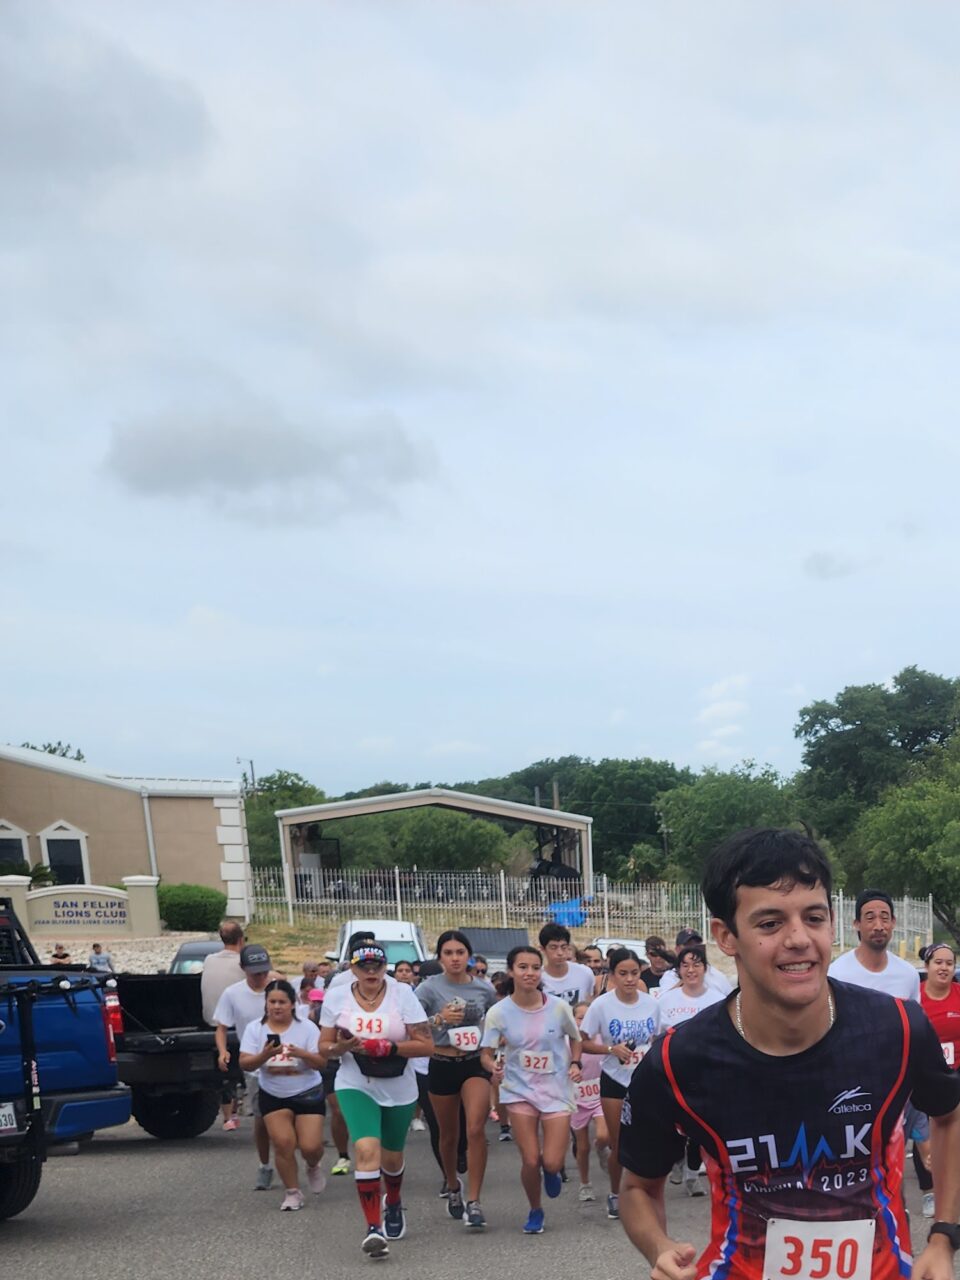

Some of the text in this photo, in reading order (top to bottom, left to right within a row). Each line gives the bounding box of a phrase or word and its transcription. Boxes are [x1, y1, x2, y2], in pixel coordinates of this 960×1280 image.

[53, 901, 125, 909] SAN FELIPE
[54, 910, 127, 918] LIONS CLUB
[356, 1018, 383, 1034] 343
[455, 1032, 477, 1047] 356
[524, 1055, 549, 1070] 327
[578, 1084, 600, 1098] 300
[821, 1168, 868, 1192] 2023
[780, 1235, 859, 1280] 350
